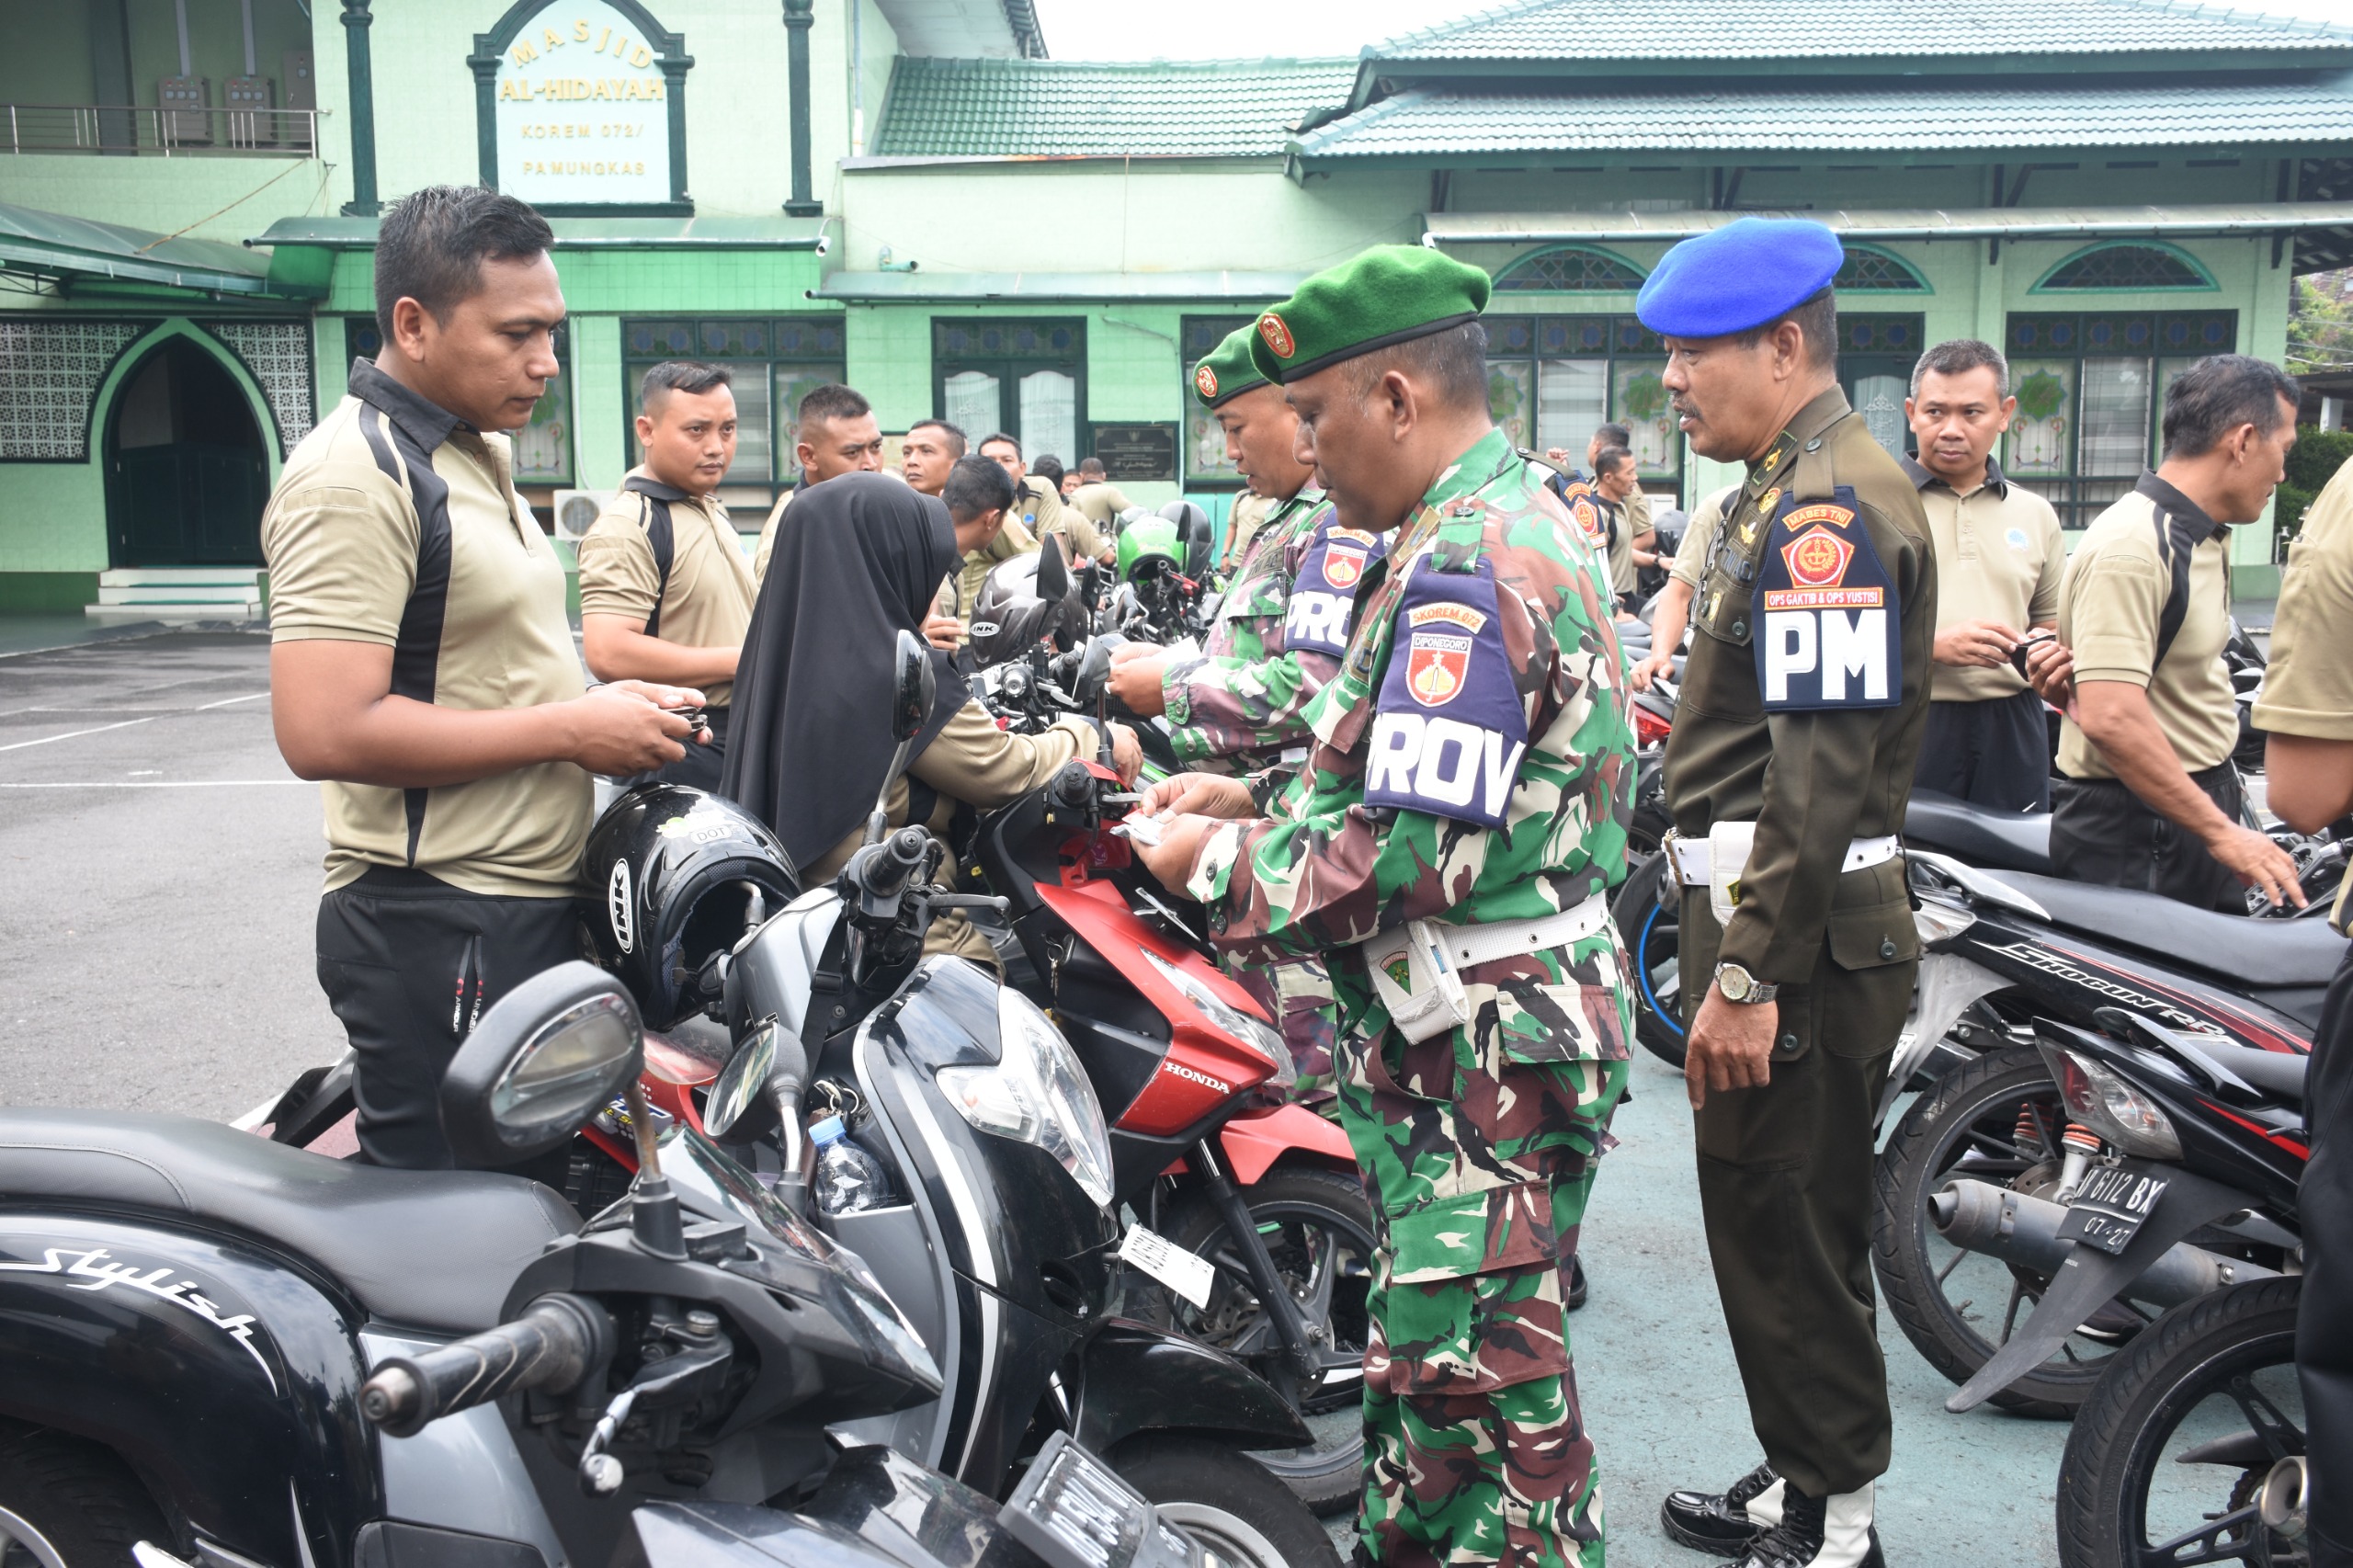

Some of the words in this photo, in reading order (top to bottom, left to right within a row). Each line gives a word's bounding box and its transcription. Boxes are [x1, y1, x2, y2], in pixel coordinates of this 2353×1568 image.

[511, 19, 652, 69] MASJID
[499, 79, 664, 101] AL-HIDAYAH
[521, 124, 591, 139] KOREM
[523, 161, 645, 176] PAMUNGKAS
[1789, 508, 1826, 527] MABES
[1830, 509, 1848, 523] TNI
[1769, 594, 1785, 607] OPS
[1786, 593, 1816, 606] GAKTIB
[1818, 593, 1824, 604] &
[1826, 592, 1845, 604] OPS
[1846, 591, 1878, 604] YUSTISI
[1413, 608, 1460, 622] SKOREM
[1462, 612, 1481, 628] 072
[1415, 637, 1468, 651] DIPONEGORO
[1765, 609, 1888, 701] PM
[1367, 711, 1526, 818] ROV
[697, 827, 726, 842] DOT
[614, 869, 631, 942] INK
[1976, 940, 2175, 1009] SHOGUN
[452, 996, 461, 1033] ARMOUR
[468, 998, 482, 1033] UNDER
[1164, 1062, 1231, 1095] HONDA
[2089, 1169, 2133, 1204] 6112
[2125, 1176, 2166, 1214] BX
[42, 1247, 274, 1374] Stylish
